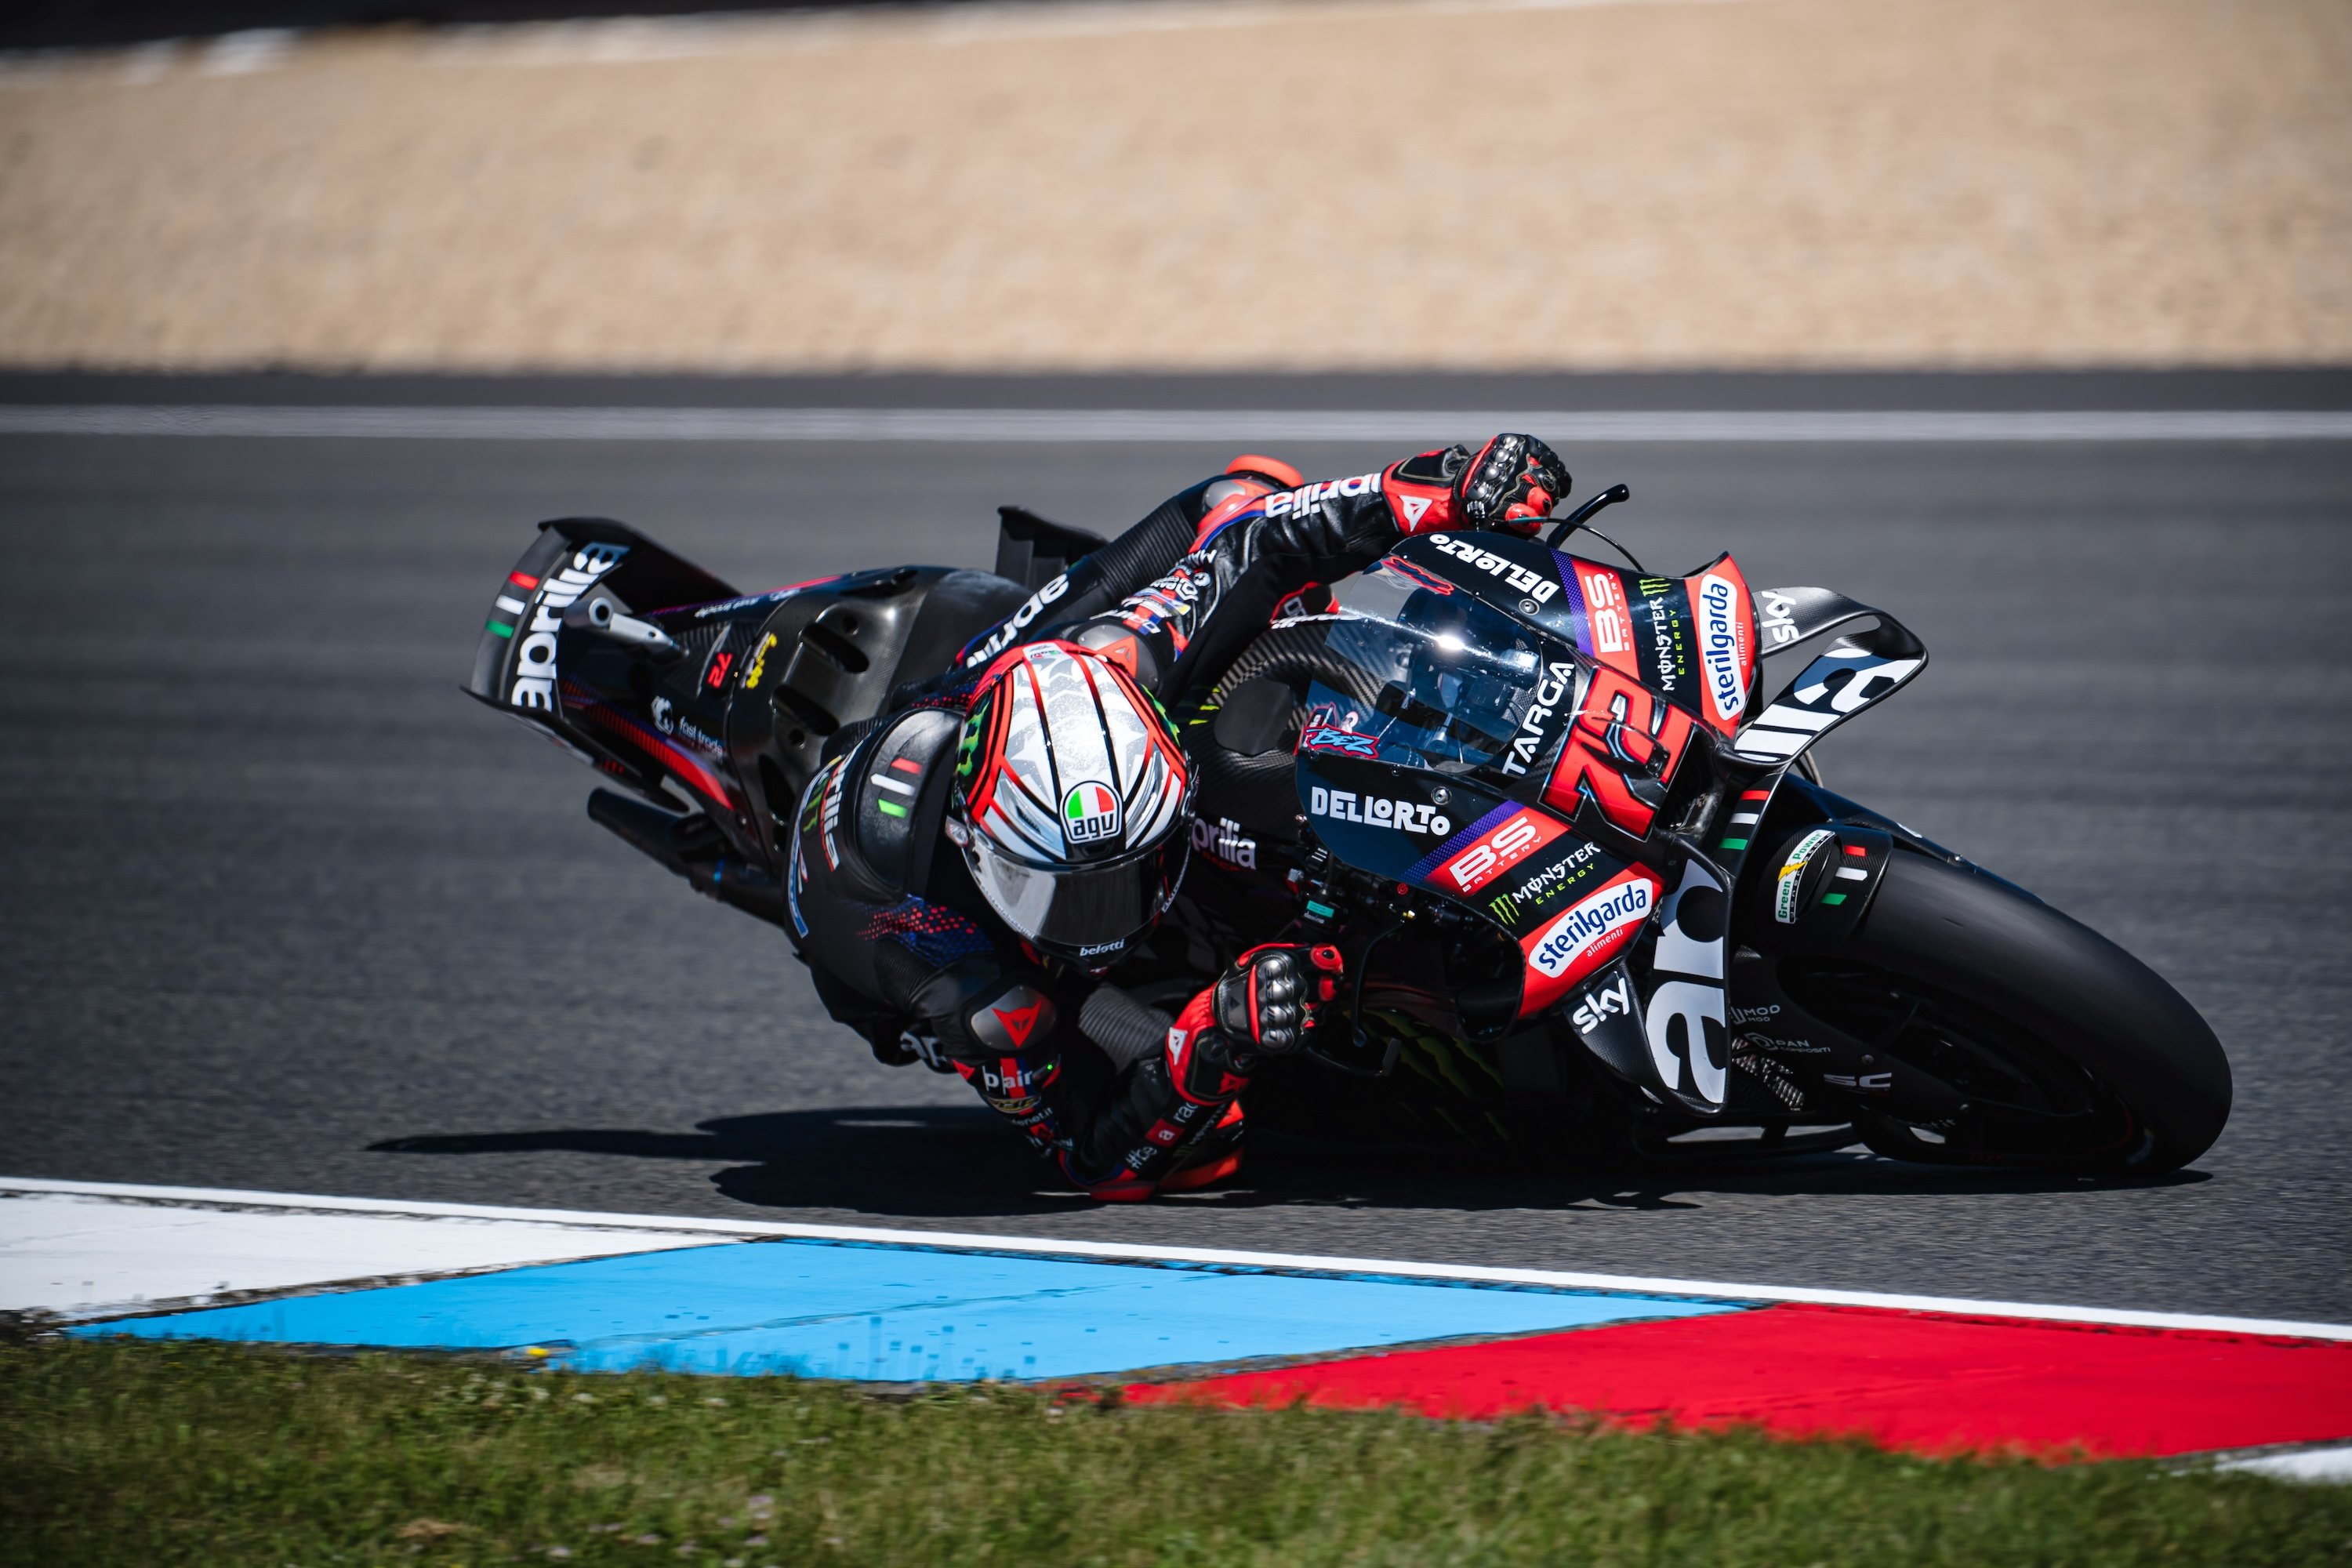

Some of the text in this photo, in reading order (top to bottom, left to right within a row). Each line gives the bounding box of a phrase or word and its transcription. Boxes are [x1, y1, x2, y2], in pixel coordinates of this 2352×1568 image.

[1265, 473, 1382, 521] prilia
[1429, 534, 1559, 603] DELLORTO
[512, 543, 630, 711] aprilia
[1584, 572, 1623, 652] BS
[1761, 590, 1800, 644] sky
[1650, 596, 1675, 692] MONSTER
[1668, 609, 1686, 676] ENERGY
[1700, 583, 1739, 712] sterilgarda
[1736, 621, 1748, 667] alimenti
[1501, 662, 1575, 776] TARGA
[1537, 665, 1695, 842] 72
[1073, 814, 1115, 838] agv
[1311, 786, 1450, 837] DELLORTO
[1192, 817, 1257, 869] prilia
[1449, 816, 1537, 888] BS
[1792, 833, 1824, 860] Power
[1511, 841, 1602, 904] MONSTER
[1535, 862, 1596, 906] ENERGY
[1778, 880, 1791, 919] Green
[1079, 939, 1125, 956] belotti
[1538, 884, 1647, 971] sterilgarda
[1585, 927, 1624, 958] alimenti
[1571, 978, 1630, 1035] sky
